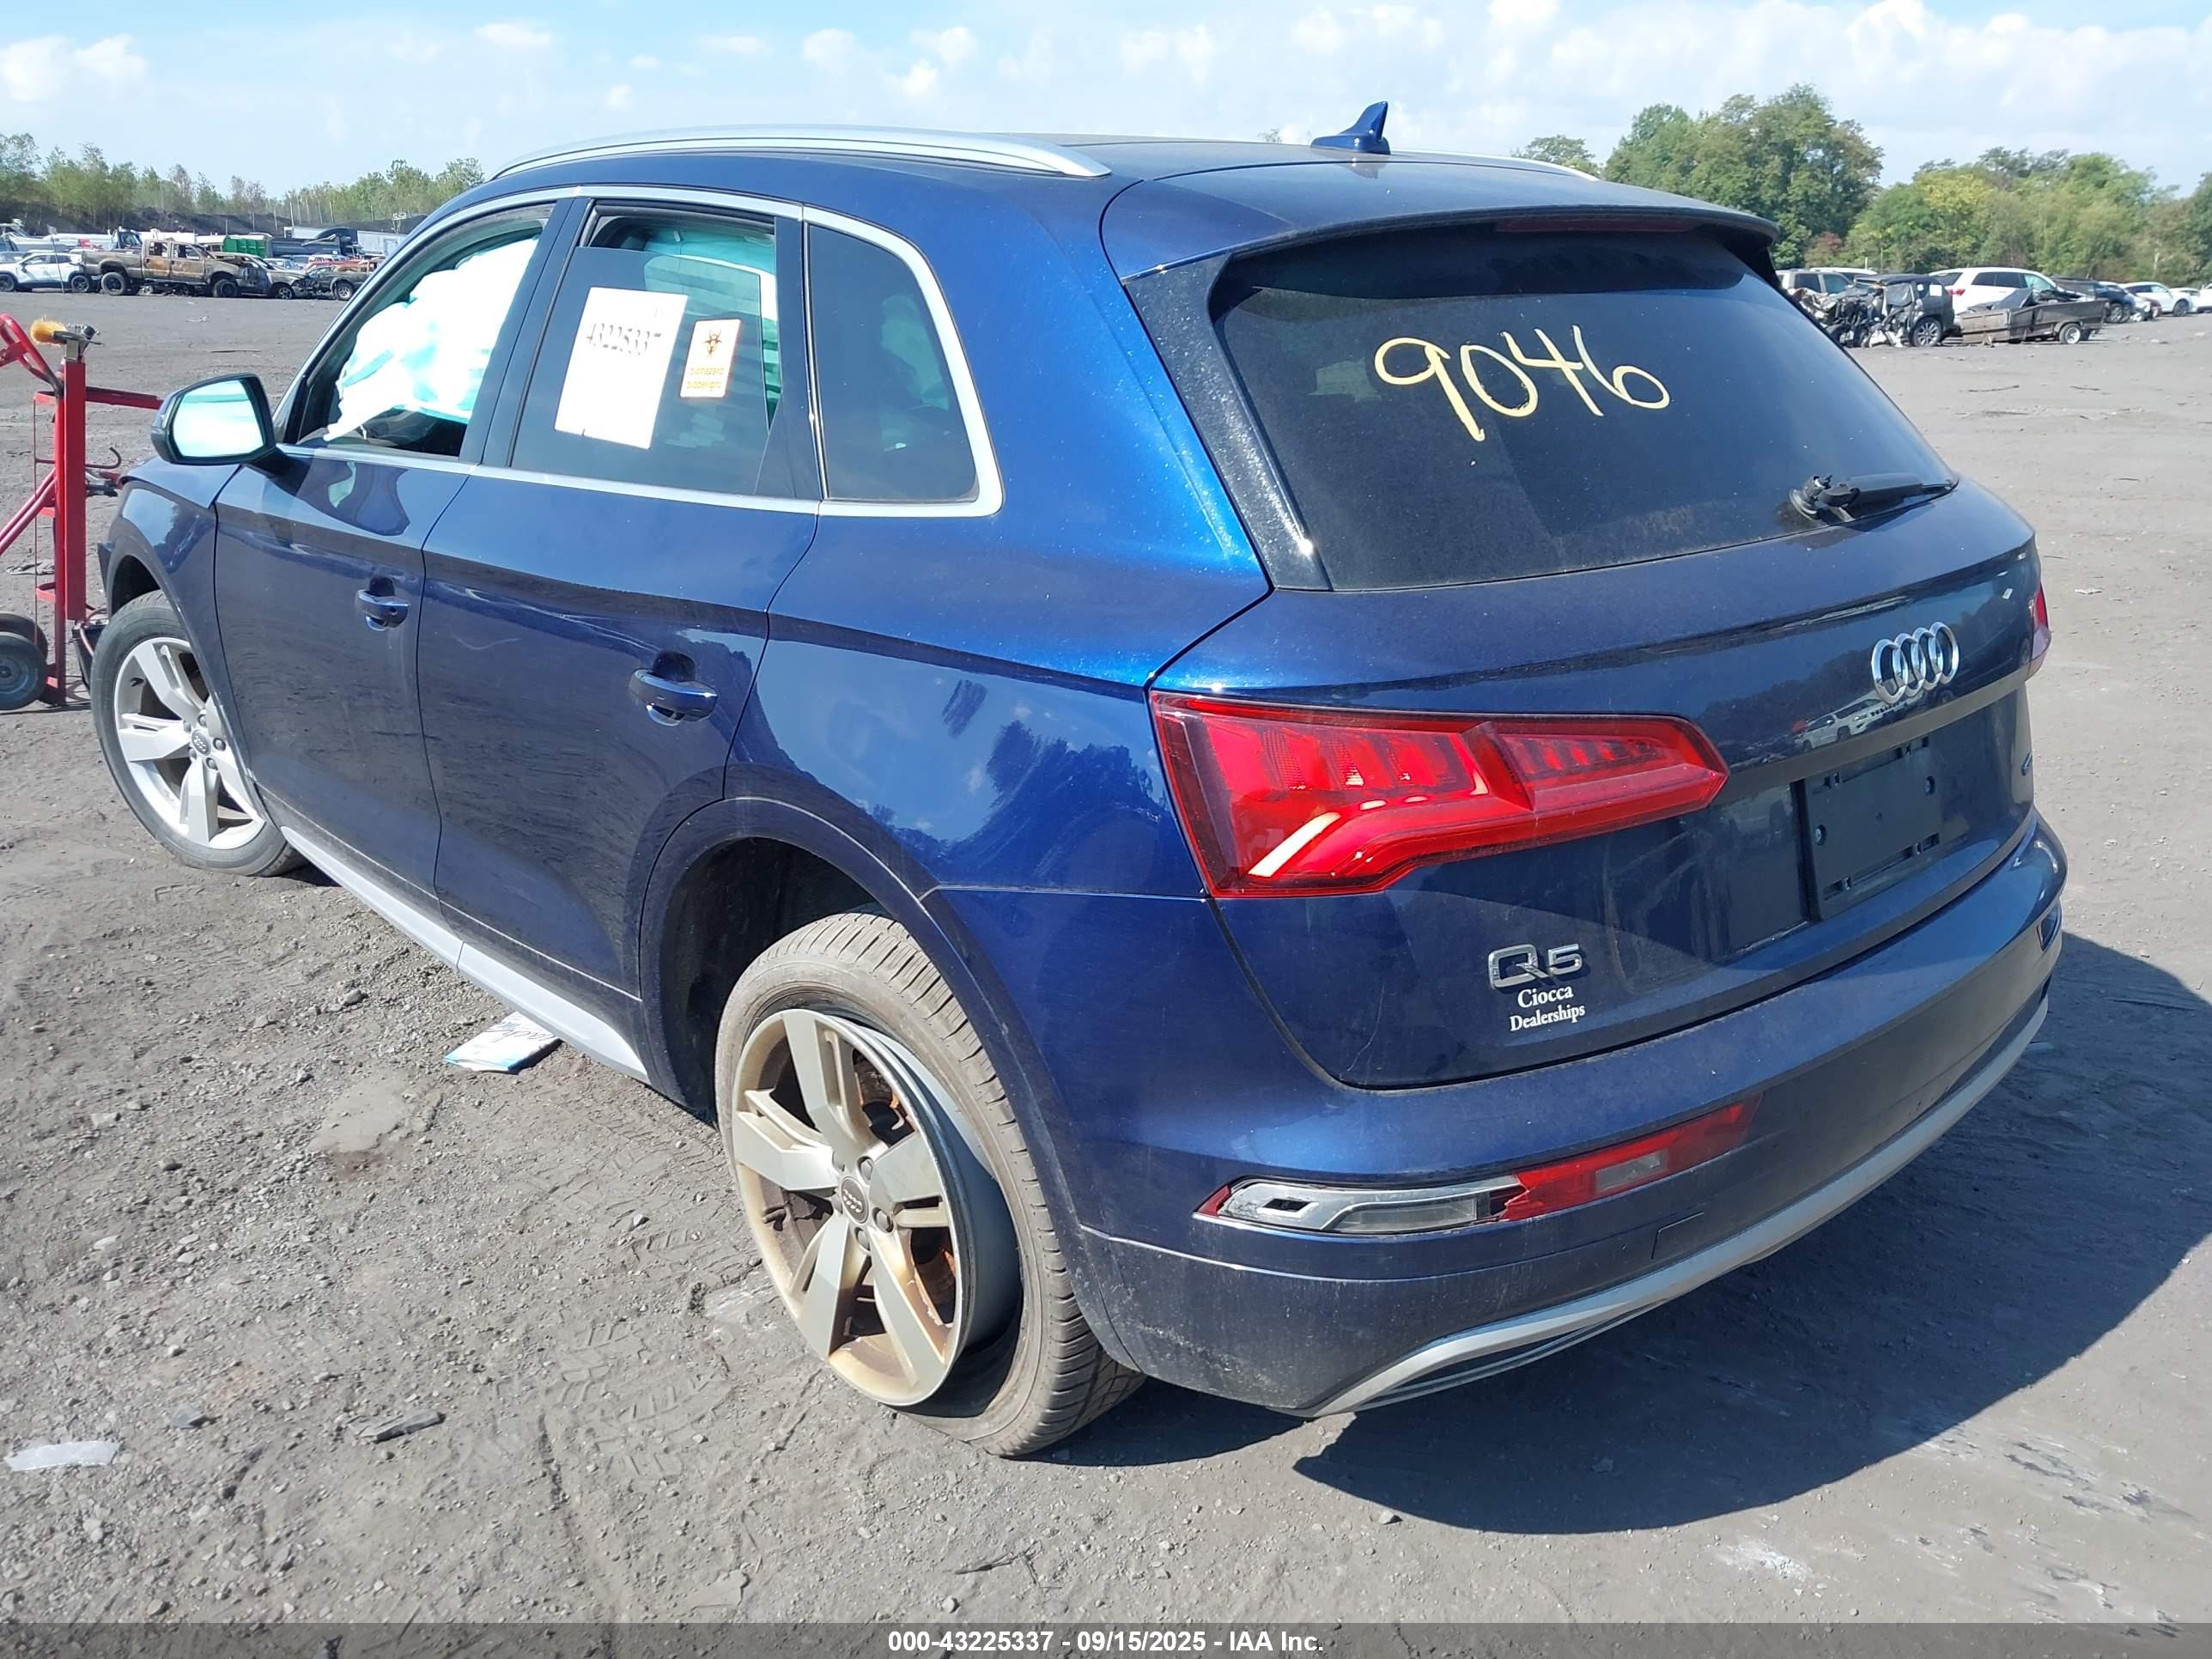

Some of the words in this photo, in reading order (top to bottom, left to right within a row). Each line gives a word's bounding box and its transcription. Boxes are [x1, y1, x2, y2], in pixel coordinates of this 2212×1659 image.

[1374, 325, 1670, 442] 9046
[1487, 943, 1583, 989] Q5
[1517, 986, 1574, 1009] Ciocca
[1509, 1004, 1586, 1031] Dealerships
